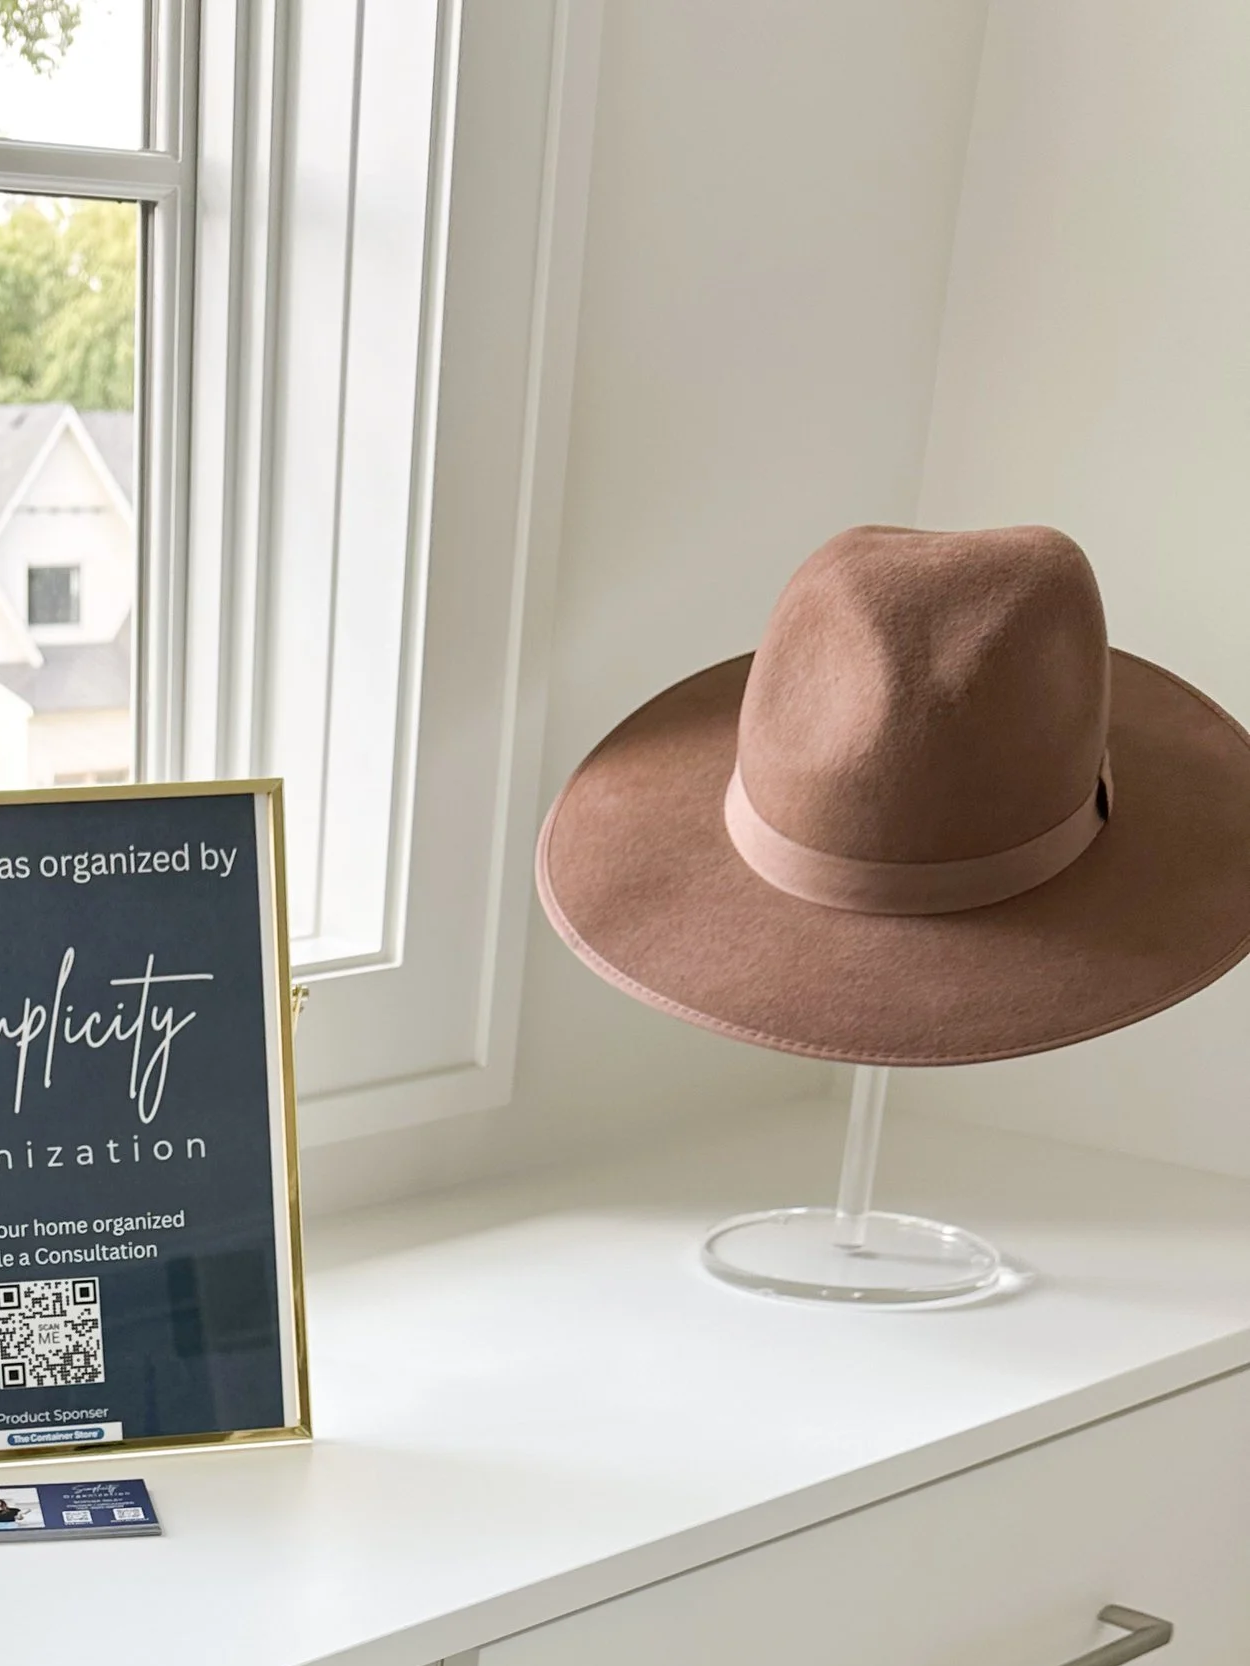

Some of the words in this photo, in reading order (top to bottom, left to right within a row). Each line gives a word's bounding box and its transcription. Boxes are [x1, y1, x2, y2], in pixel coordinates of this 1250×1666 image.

[39, 842, 190, 884] organized
[200, 841, 237, 878] by
[33, 1218, 88, 1237] home
[92, 1209, 185, 1235] organized
[18, 1251, 31, 1267] a
[34, 1241, 158, 1265] Consultation
[38, 1323, 60, 1331] SCAN
[38, 1331, 61, 1344] ME
[52, 1407, 110, 1423] Sponser
[13, 1435, 30, 1444] The
[30, 1431, 73, 1442] Container
[74, 1429, 98, 1439] Store
